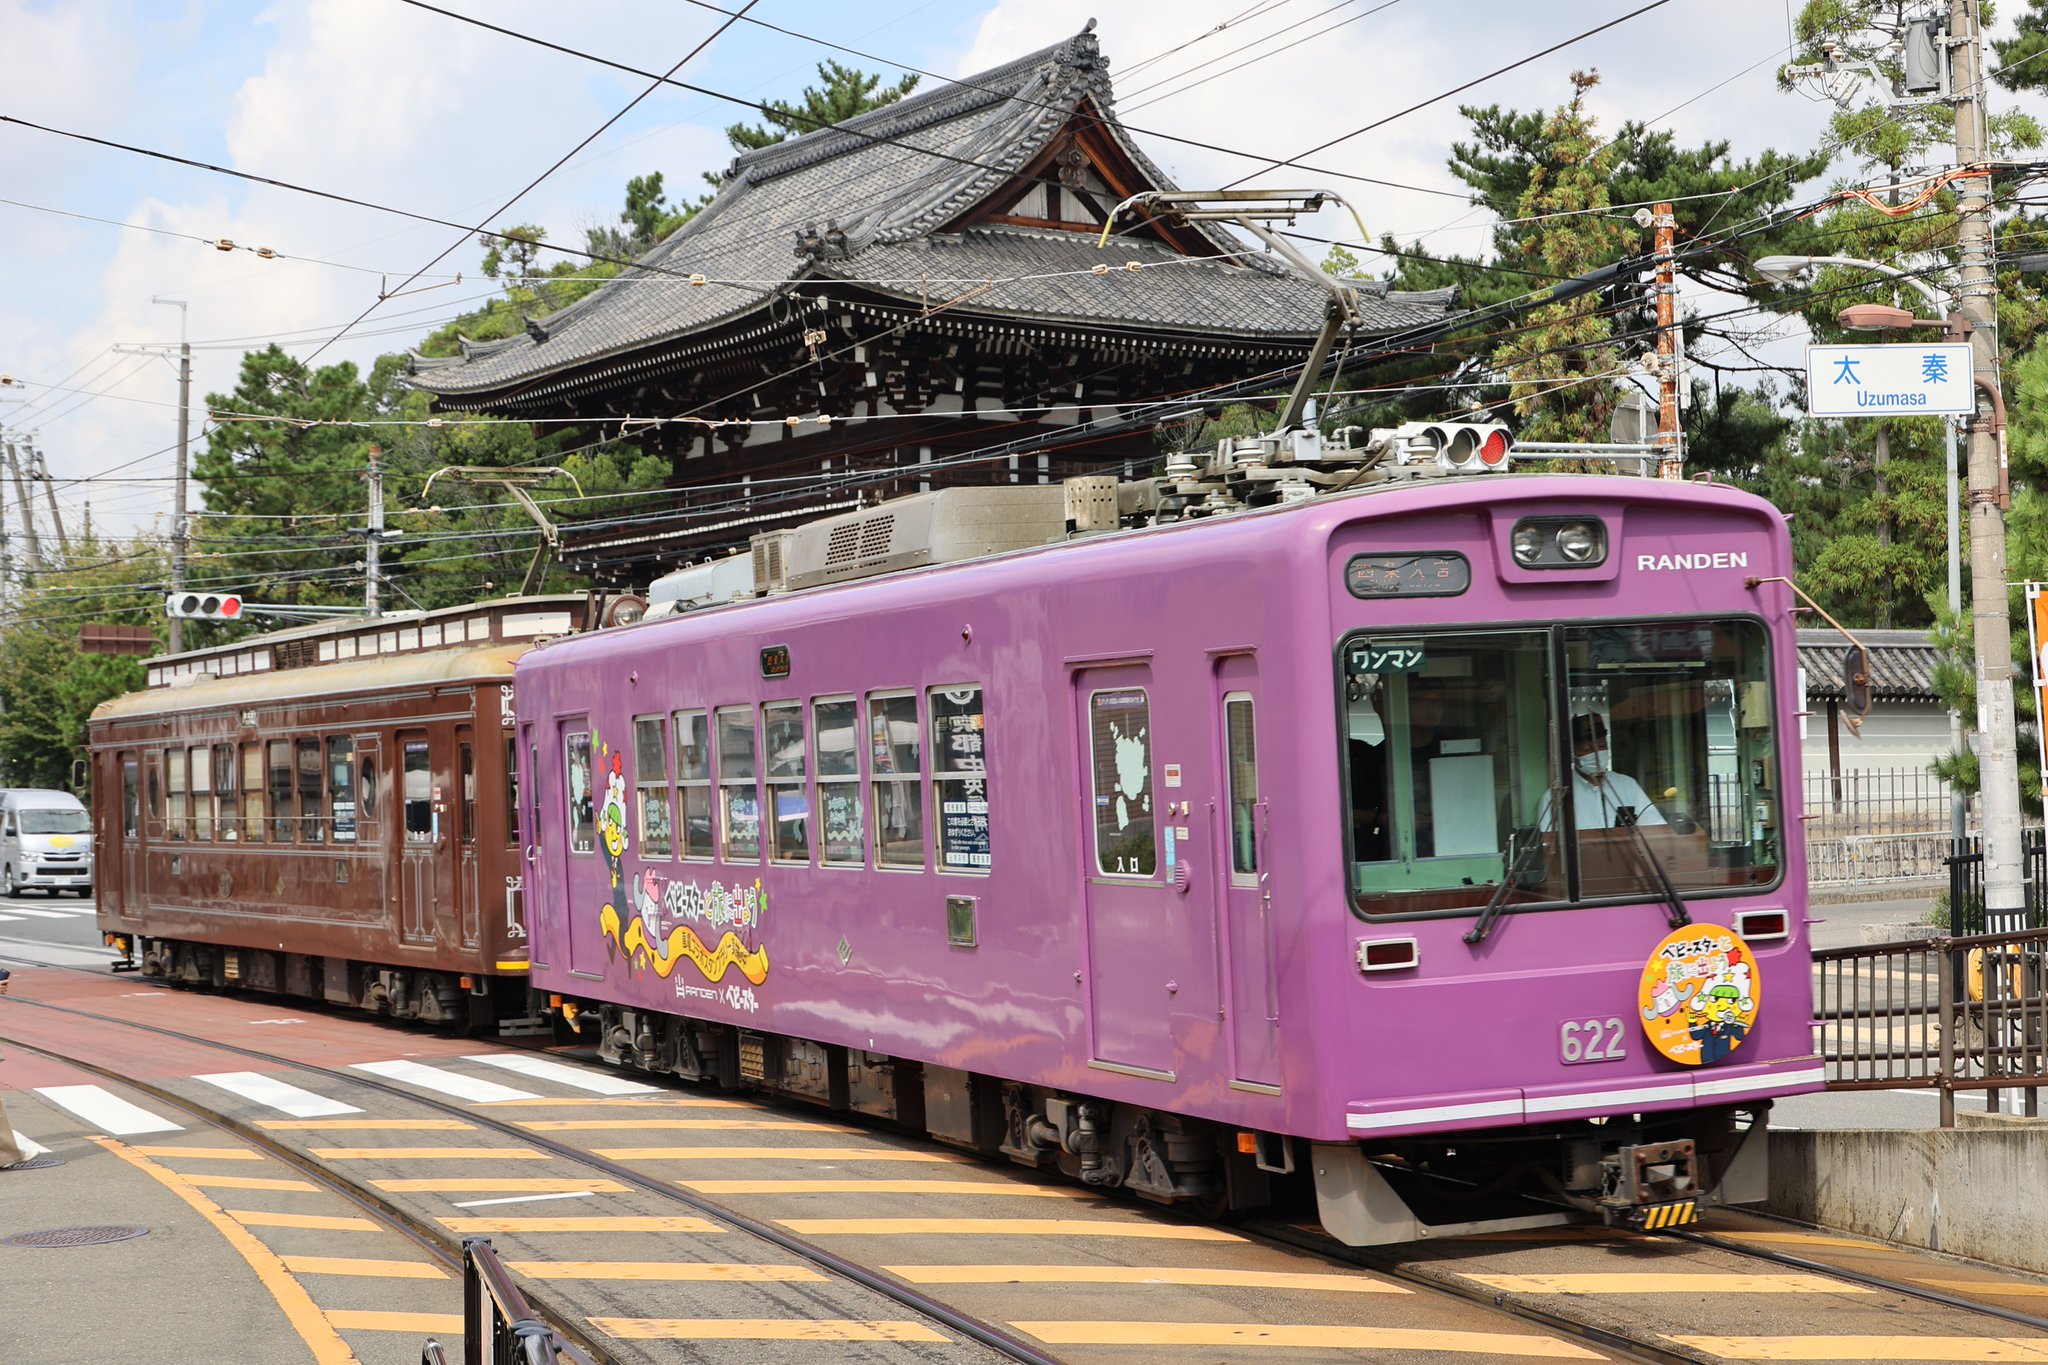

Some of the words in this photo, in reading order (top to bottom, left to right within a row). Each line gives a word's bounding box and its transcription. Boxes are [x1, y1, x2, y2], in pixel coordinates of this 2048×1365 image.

[1833, 353, 1948, 385] 太秦
[1857, 390, 1927, 407] Uzumasa
[1637, 552, 1748, 571] RANDEN
[1352, 649, 1423, 669] ワンマン
[1116, 856, 1139, 873] 入口
[1661, 936, 1733, 958] ベビースターと
[1668, 954, 1728, 981] 旅に出よう
[726, 985, 759, 1013] ベビースター
[1561, 1018, 1626, 1061] 622
